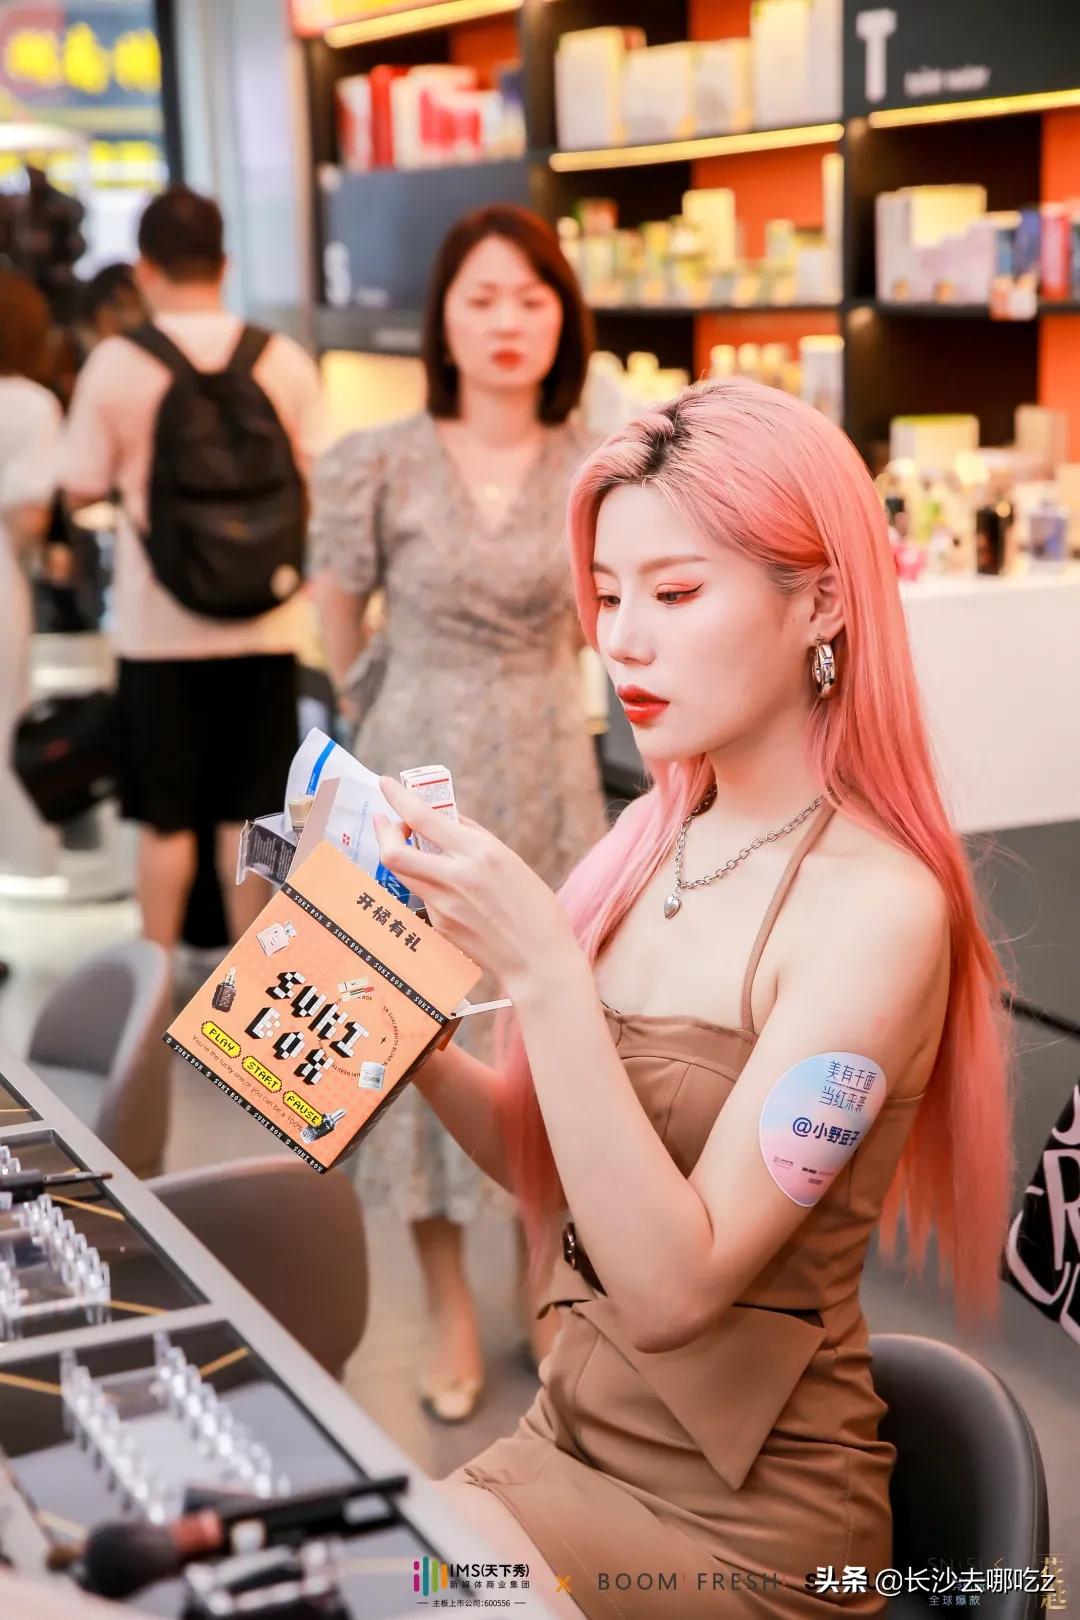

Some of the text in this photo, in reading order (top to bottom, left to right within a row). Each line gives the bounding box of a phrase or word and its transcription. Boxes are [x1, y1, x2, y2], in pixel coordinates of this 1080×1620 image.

[357, 892, 421, 952] 开橘有礼
[265, 972, 370, 1058] SUKI
[209, 1028, 235, 1051] PLAY
[219, 1059, 234, 1073] lucky
[251, 1087, 262, 1097] you
[263, 1097, 273, 1106] can
[247, 1062, 279, 1088] START
[827, 1059, 877, 1091] 美有千面
[287, 1095, 319, 1124] PAUSE
[792, 1116, 860, 1146] @小野豆子
